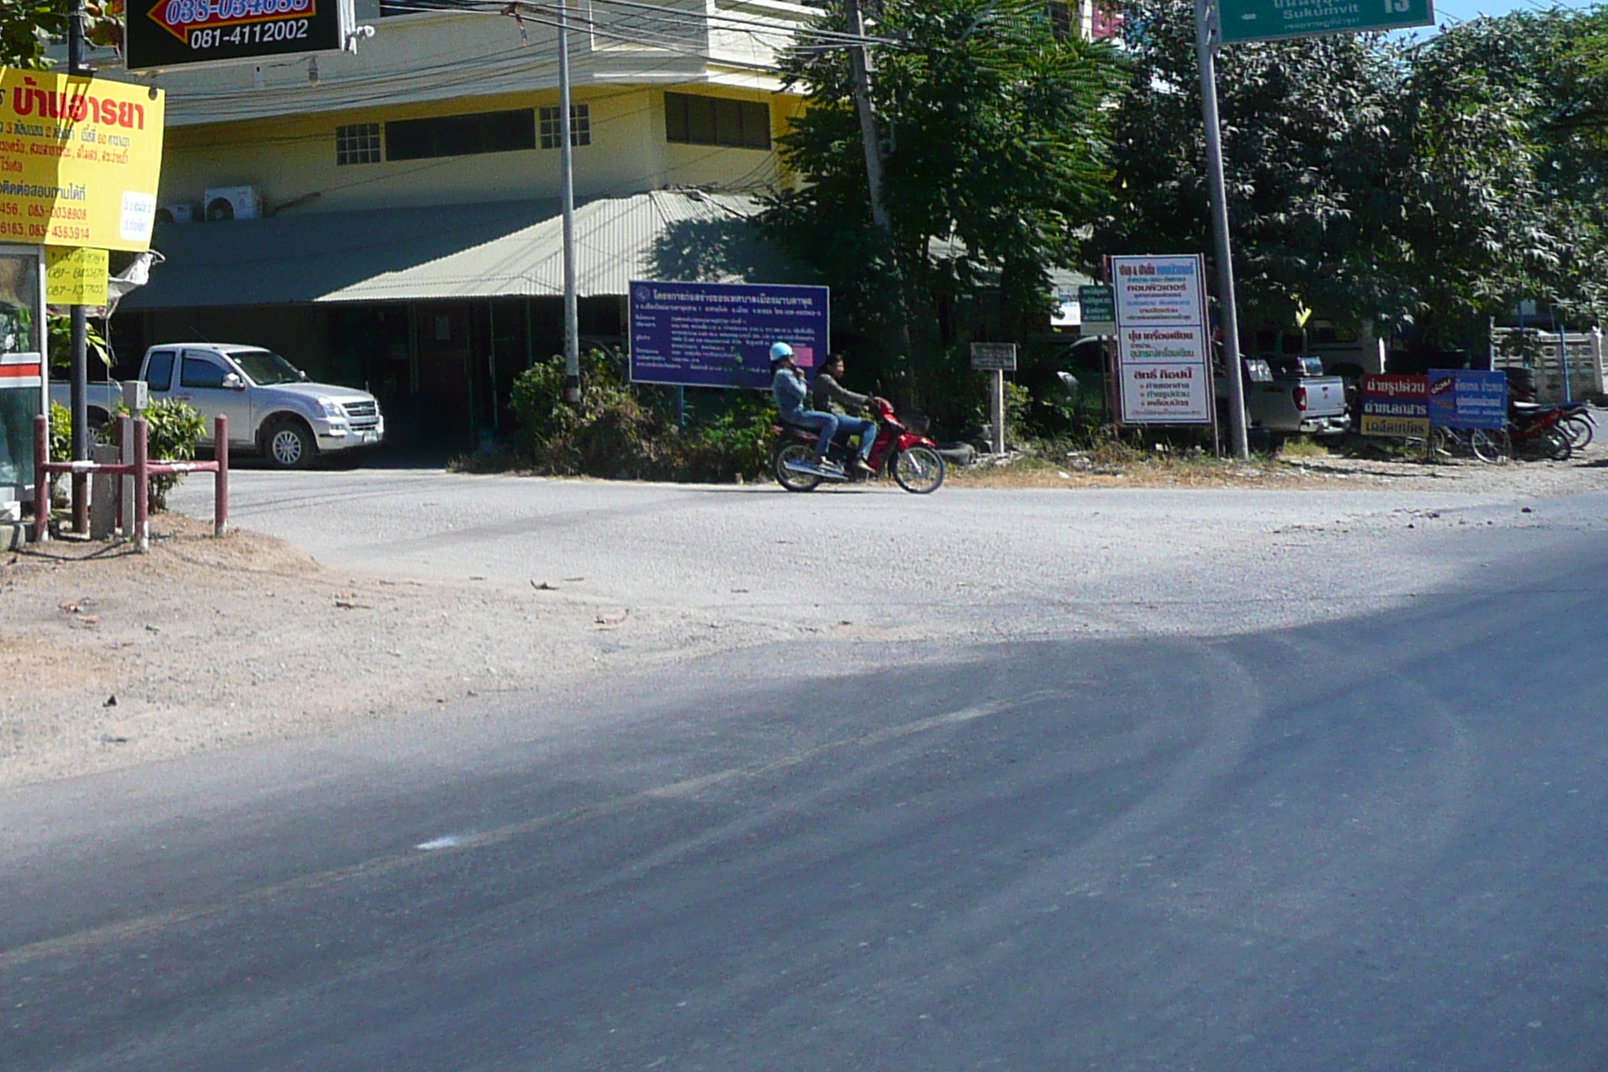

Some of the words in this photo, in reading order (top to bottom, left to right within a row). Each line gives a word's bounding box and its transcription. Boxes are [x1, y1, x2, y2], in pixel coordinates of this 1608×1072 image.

[1283, 3, 1360, 20] Sukumvit
[190, 19, 309, 49] 081-4112002
[13, 76, 144, 130] บ้านอารยา
[6, 121, 14, 134] 3
[1367, 377, 1426, 396] ถ่ายรูปด่วน
[1364, 399, 1428, 415] ถ่ายเอกสาร
